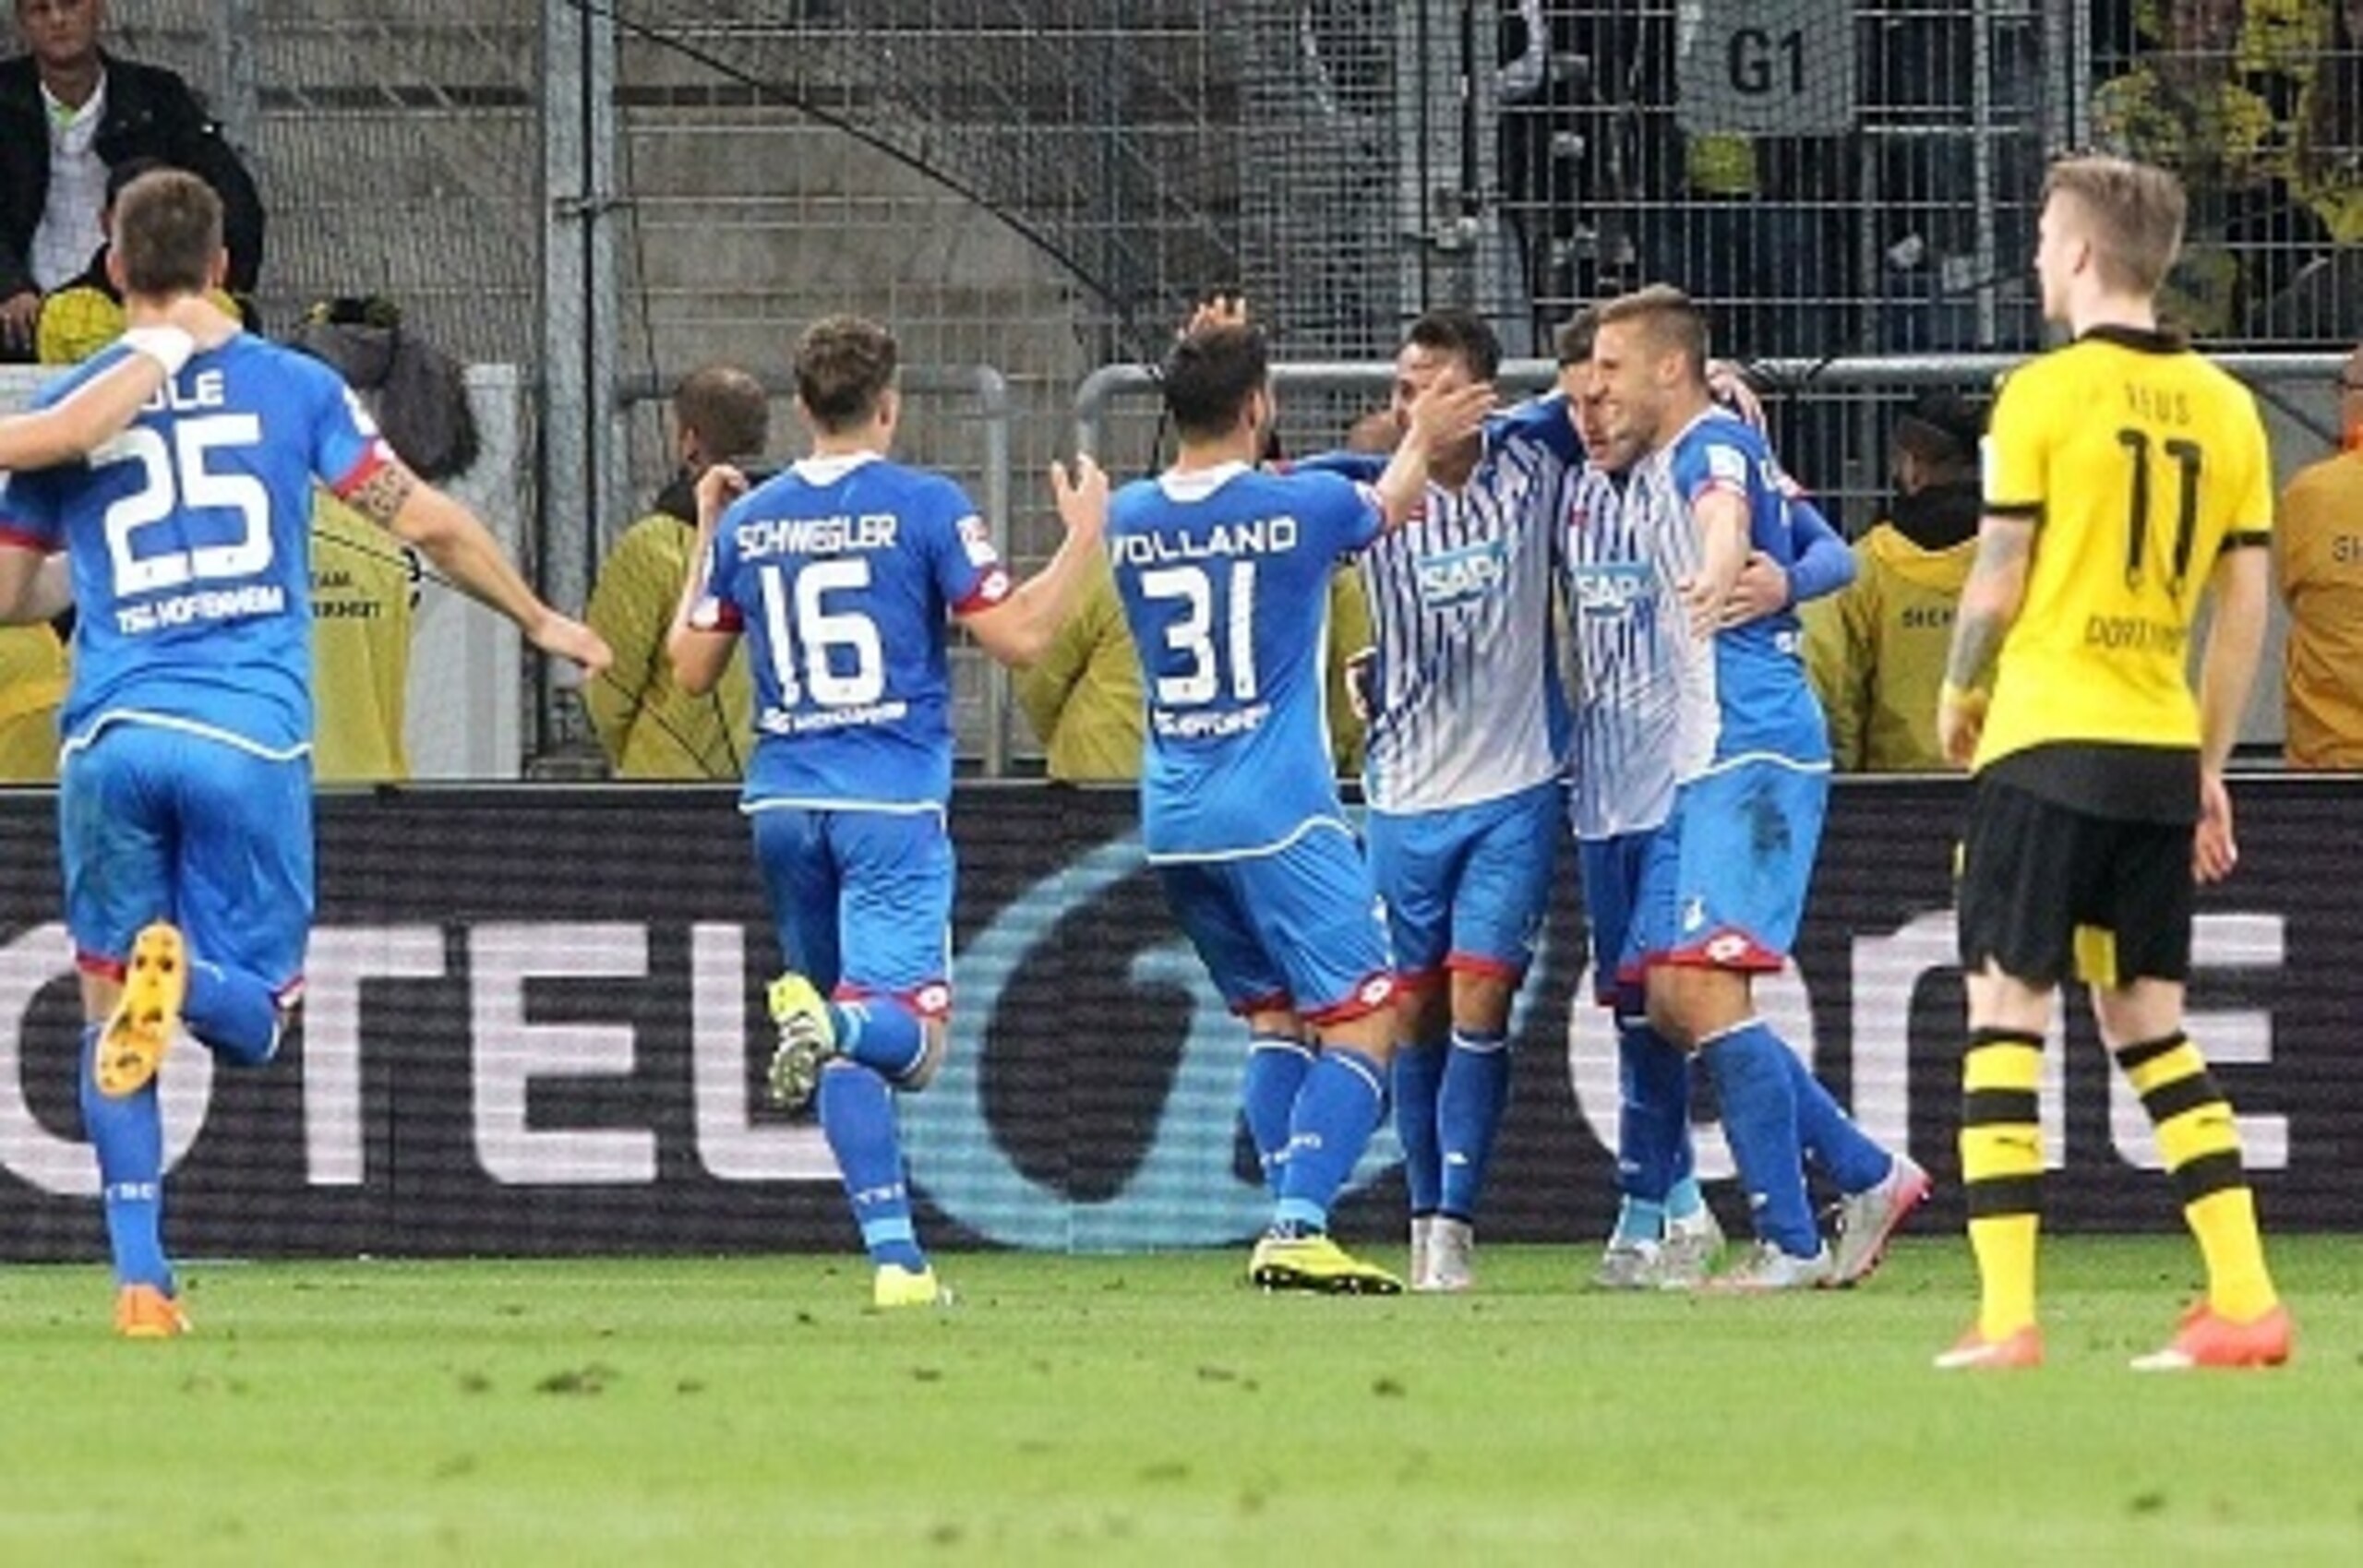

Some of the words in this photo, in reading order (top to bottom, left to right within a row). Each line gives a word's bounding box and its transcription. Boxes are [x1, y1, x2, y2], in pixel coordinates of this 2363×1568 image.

[1729, 30, 1802, 94] G1
[90, 413, 274, 598] 25
[736, 514, 897, 561] SCHWEGLER
[2117, 428, 2202, 592] 11
[1424, 557, 1497, 595] SAP
[1577, 574, 1642, 602] SAP
[760, 559, 884, 706] 16
[1142, 560, 1256, 703] 31
